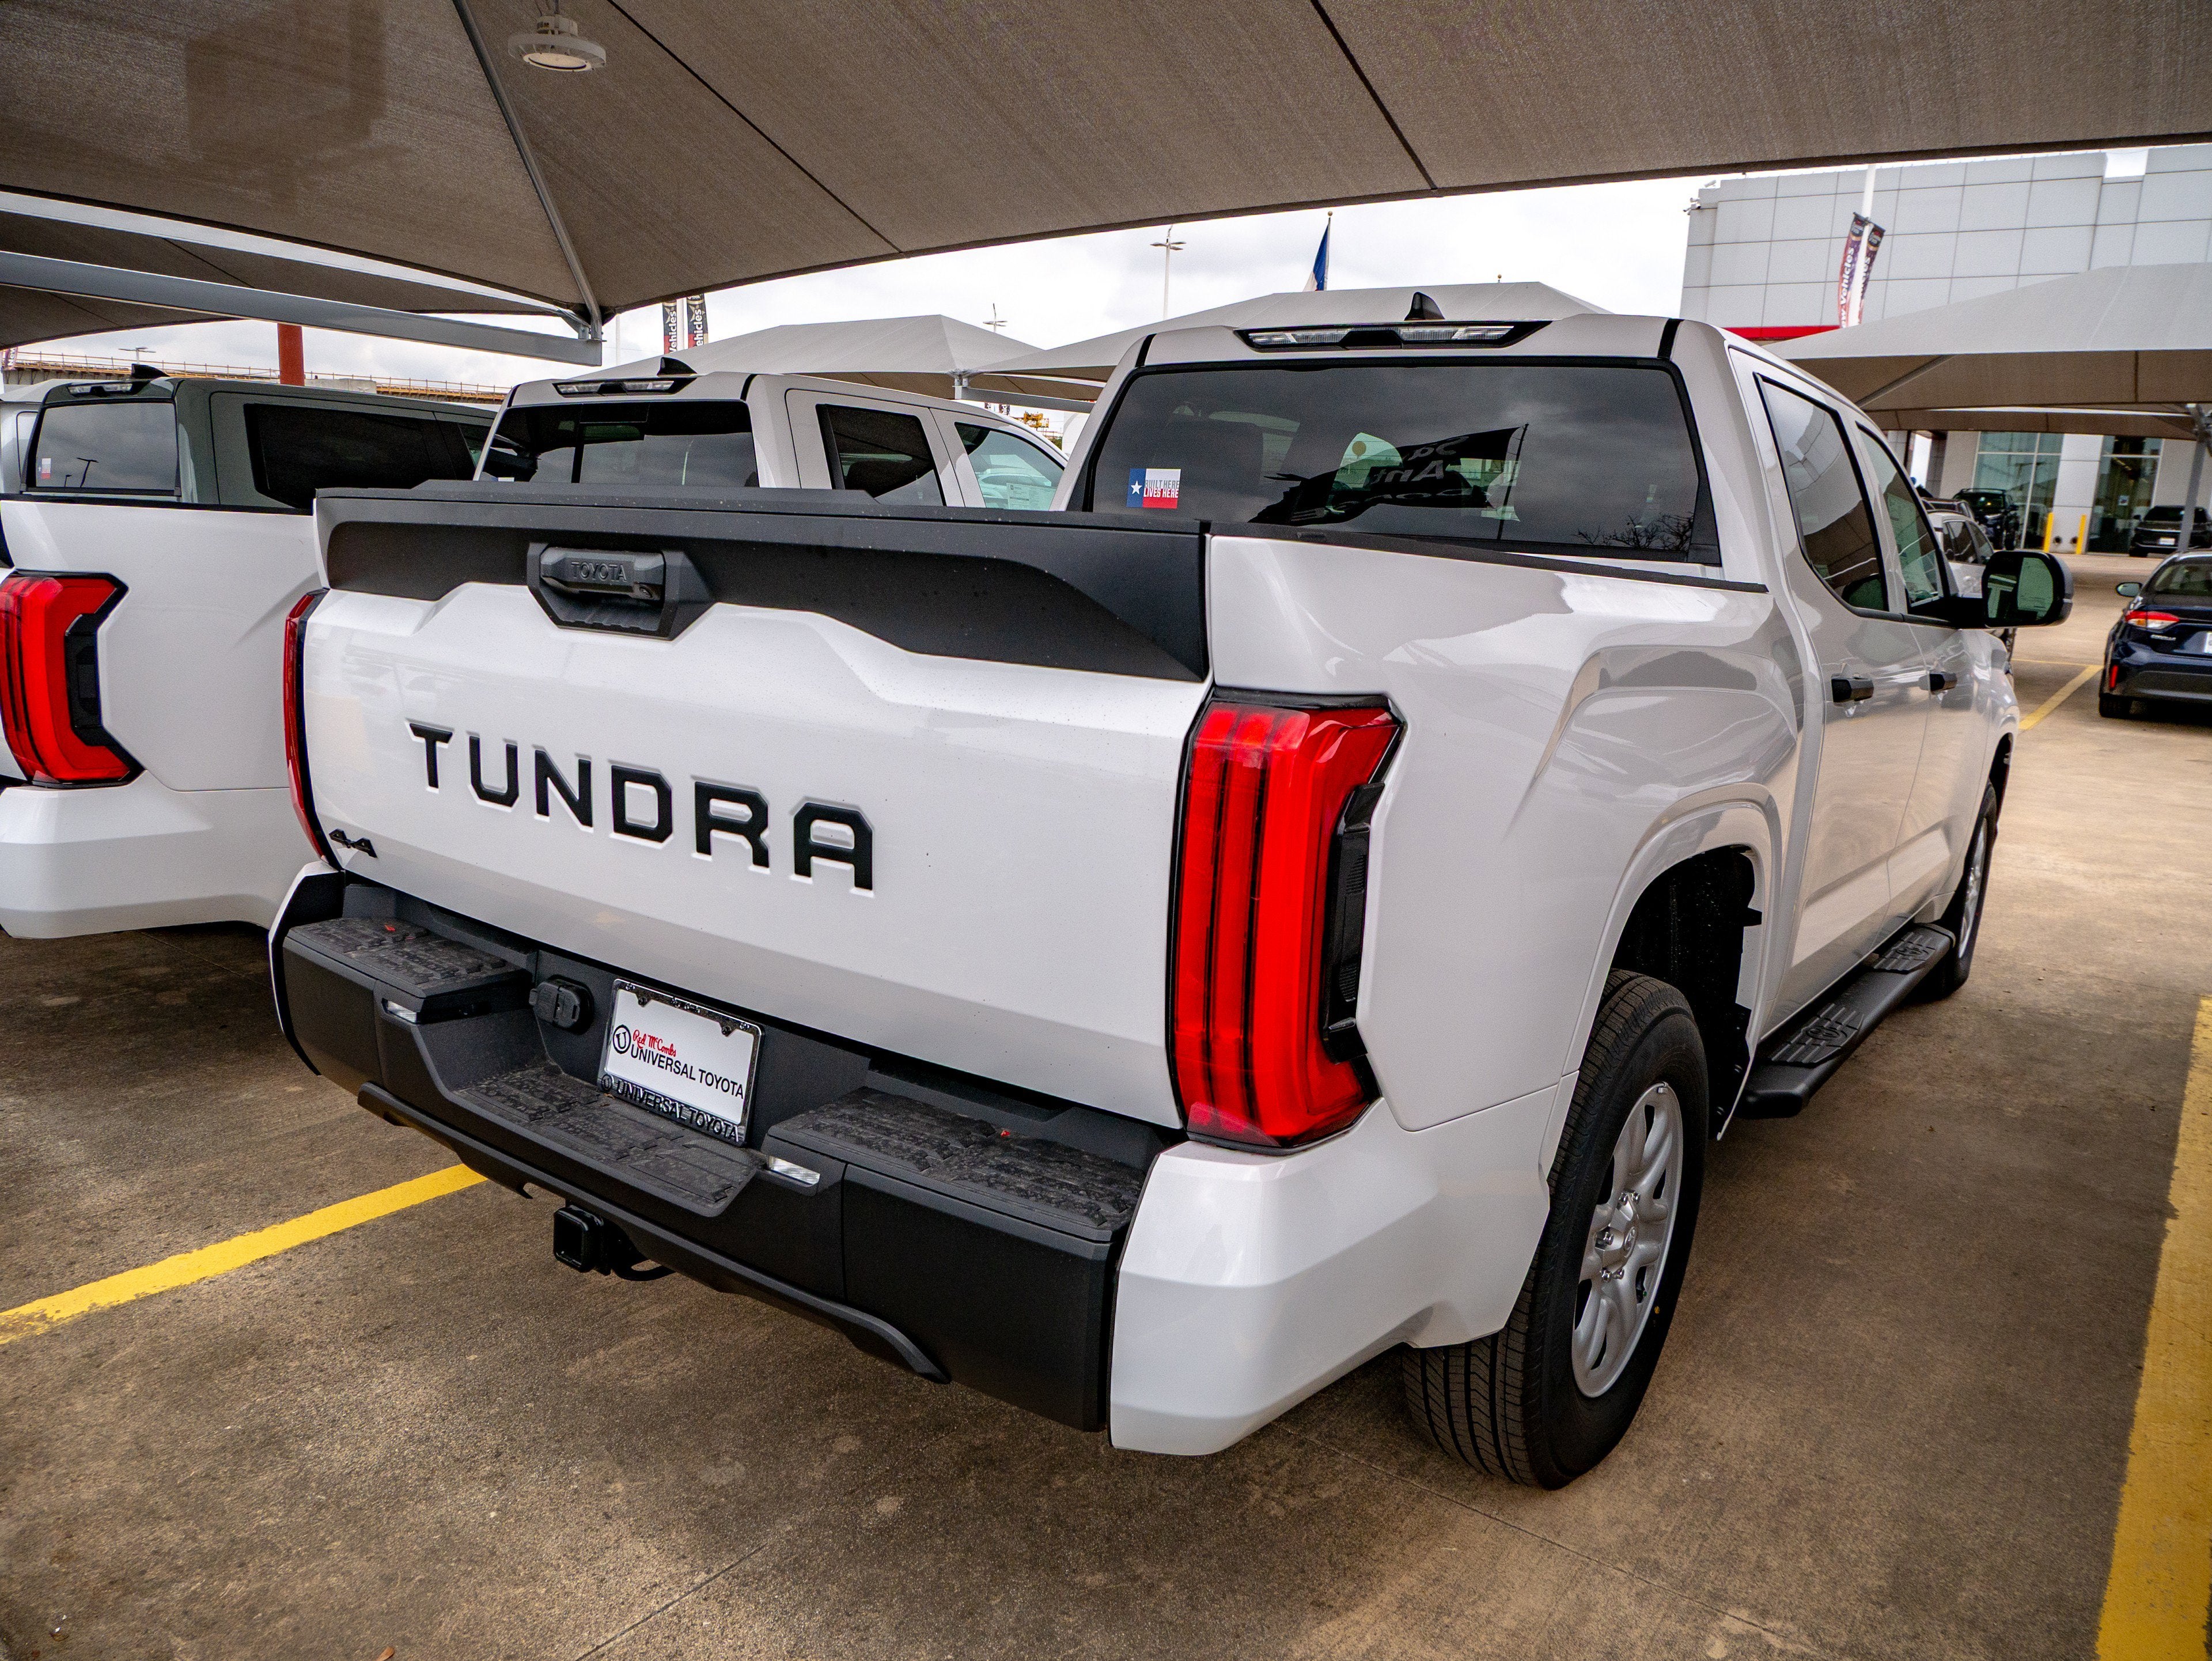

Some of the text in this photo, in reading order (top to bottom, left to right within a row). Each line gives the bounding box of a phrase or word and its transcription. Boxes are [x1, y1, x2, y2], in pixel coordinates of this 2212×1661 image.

[1840, 247, 1854, 305] Vehicles
[694, 309, 703, 347] ehicles
[1143, 488, 1179, 498] LIVES HERE
[1145, 479, 1180, 490] BUILT HERE
[571, 562, 627, 582] TOYOTA
[407, 721, 874, 894] TUNDRA
[633, 1029, 676, 1057] Red McCombs
[630, 1044, 744, 1099] UNIVERSAL TOYOTA
[616, 1079, 688, 1121] UNIVERSAL
[689, 1108, 740, 1142] TOYOTA
